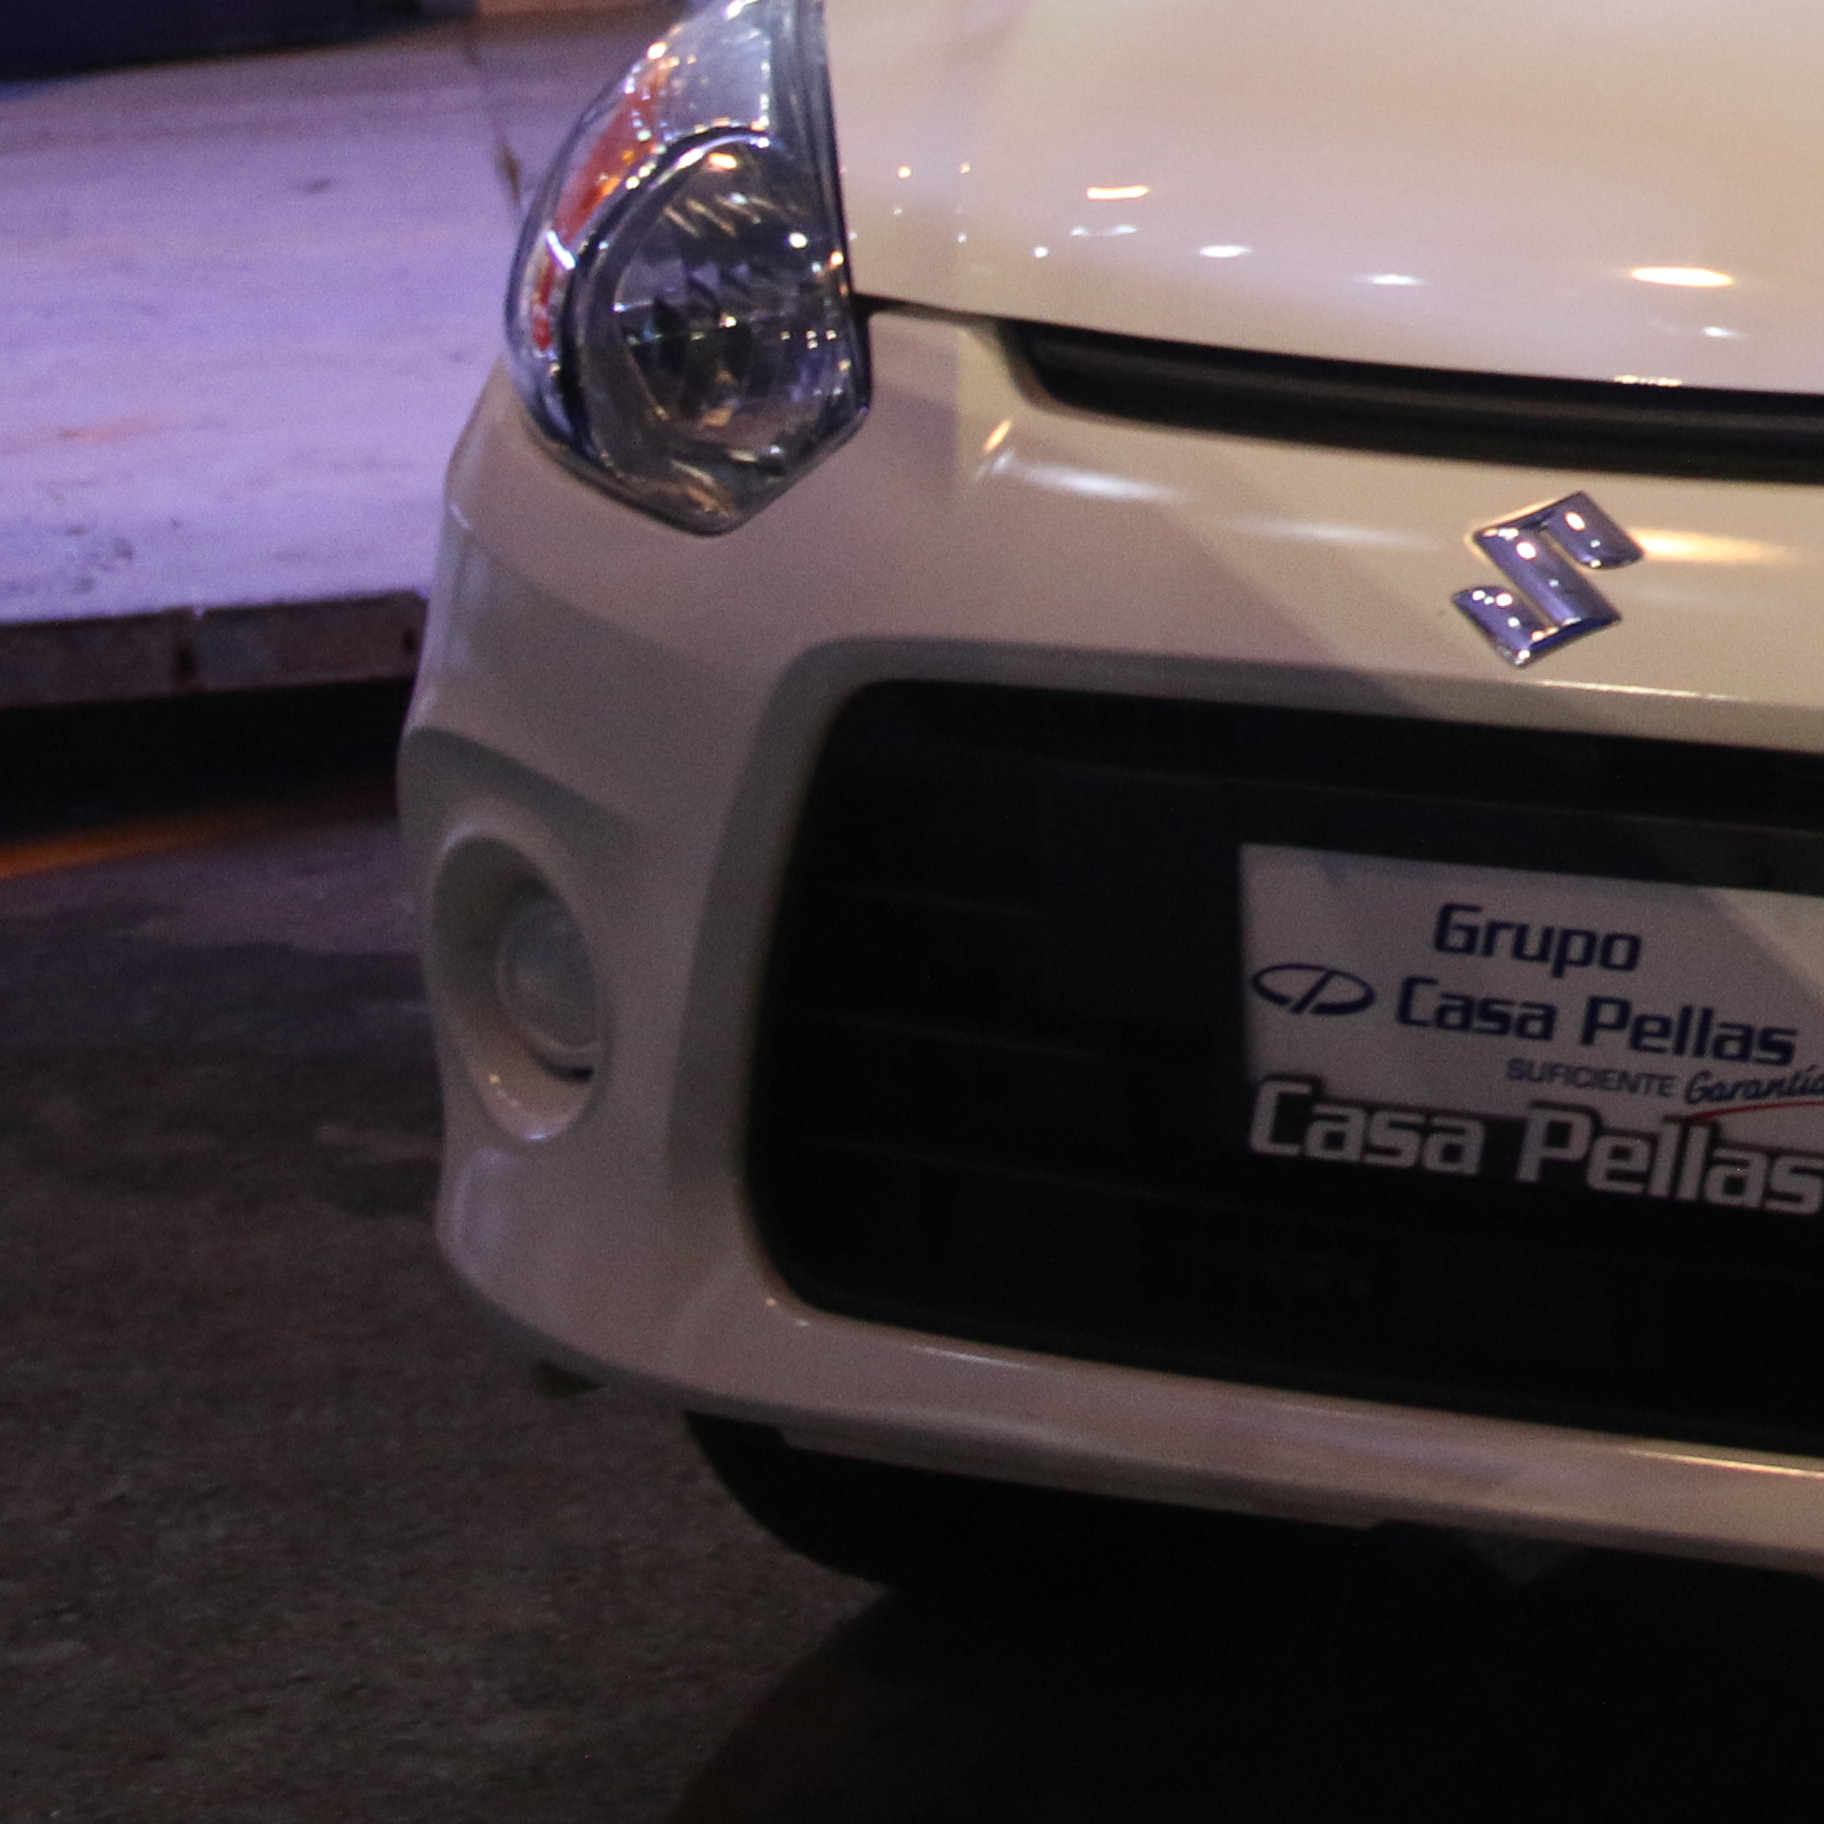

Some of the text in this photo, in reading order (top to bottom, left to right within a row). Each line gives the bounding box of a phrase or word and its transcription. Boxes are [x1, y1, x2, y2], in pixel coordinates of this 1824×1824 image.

[1433, 901, 1643, 979] Grupo
[1394, 975, 1800, 1067] Casa Pellas
[1505, 1058, 1680, 1098] SUFICIENTE
[1249, 1077, 1488, 1176] Casa
